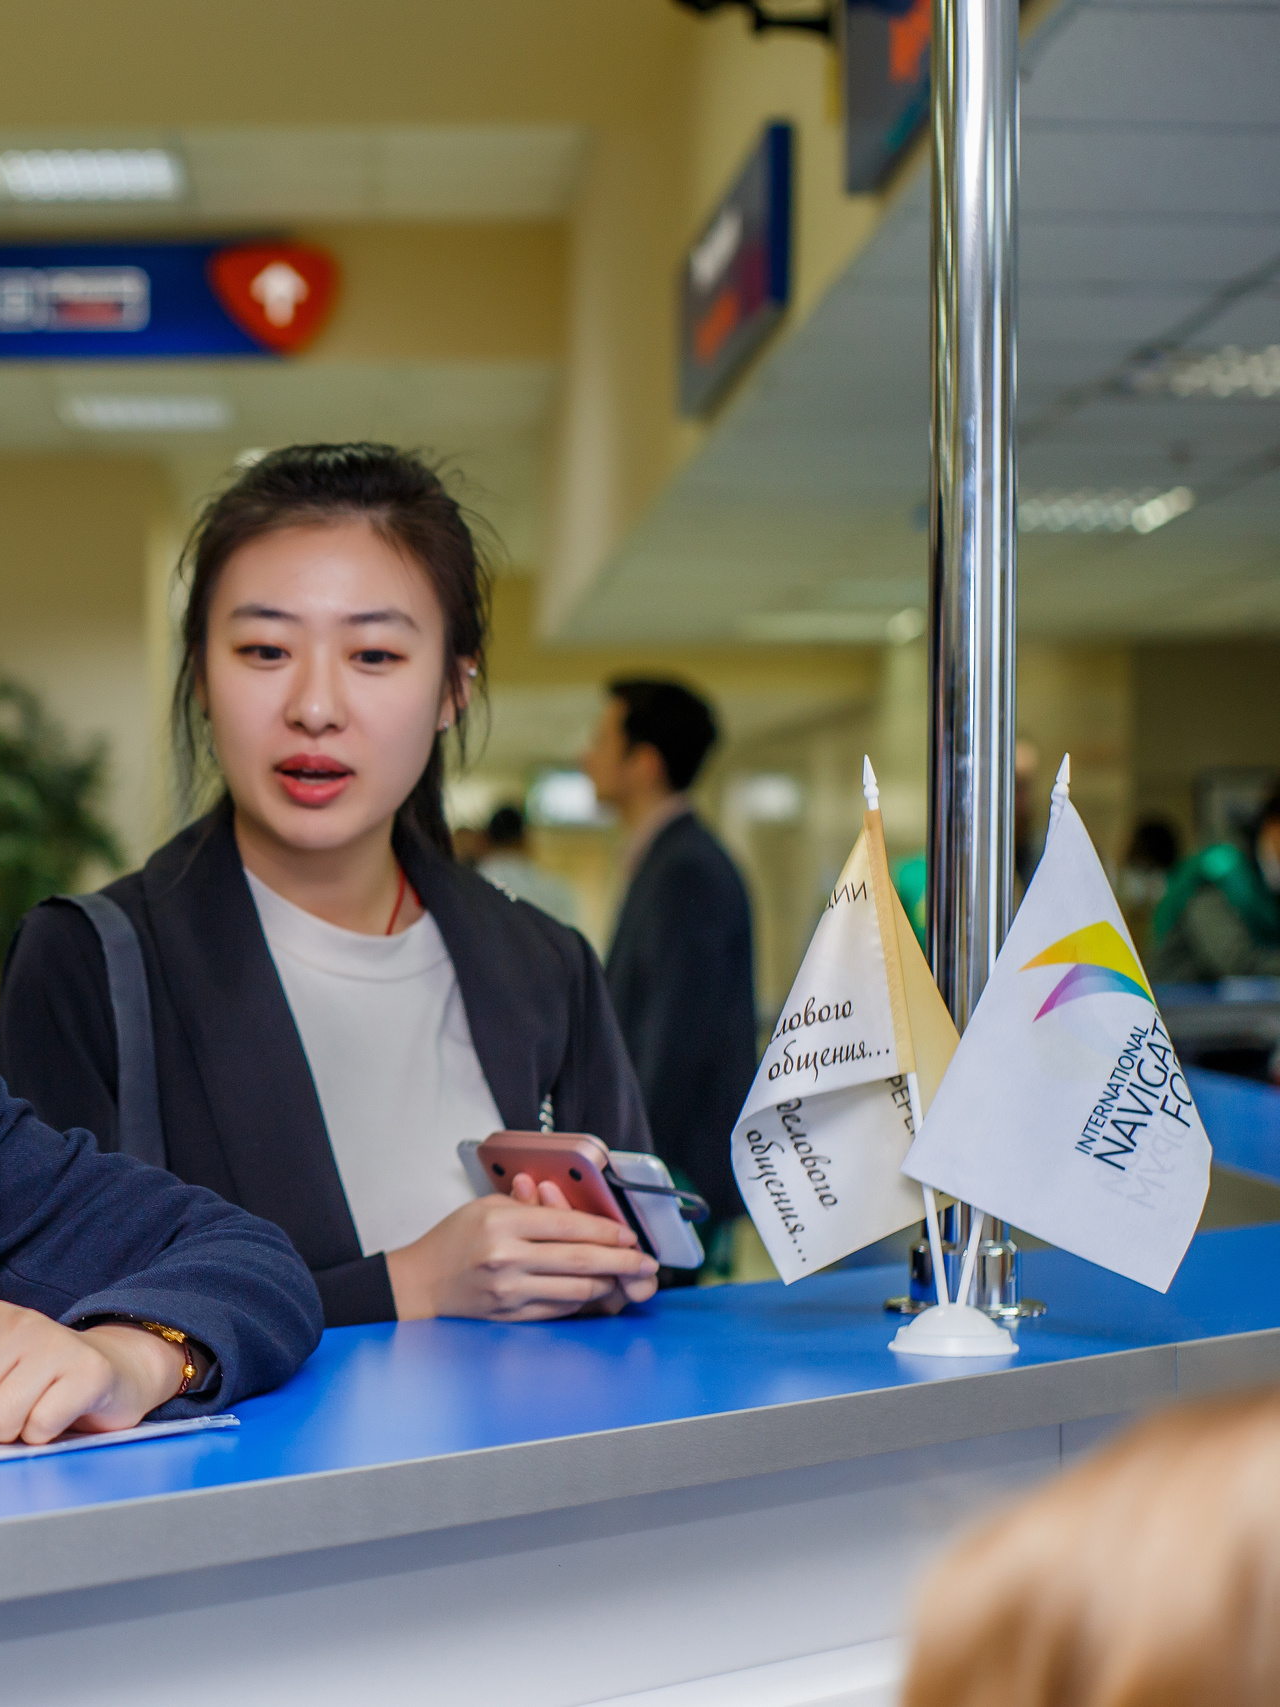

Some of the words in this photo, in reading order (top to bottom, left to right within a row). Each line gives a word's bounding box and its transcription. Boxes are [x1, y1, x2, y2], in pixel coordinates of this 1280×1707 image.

[770, 996, 853, 1044] лового
[768, 1040, 890, 1083] общения...
[1074, 1025, 1149, 1156] INTERNATIONAL
[1093, 1010, 1172, 1171] NAVIGAT
[1159, 1055, 1192, 1128] FO
